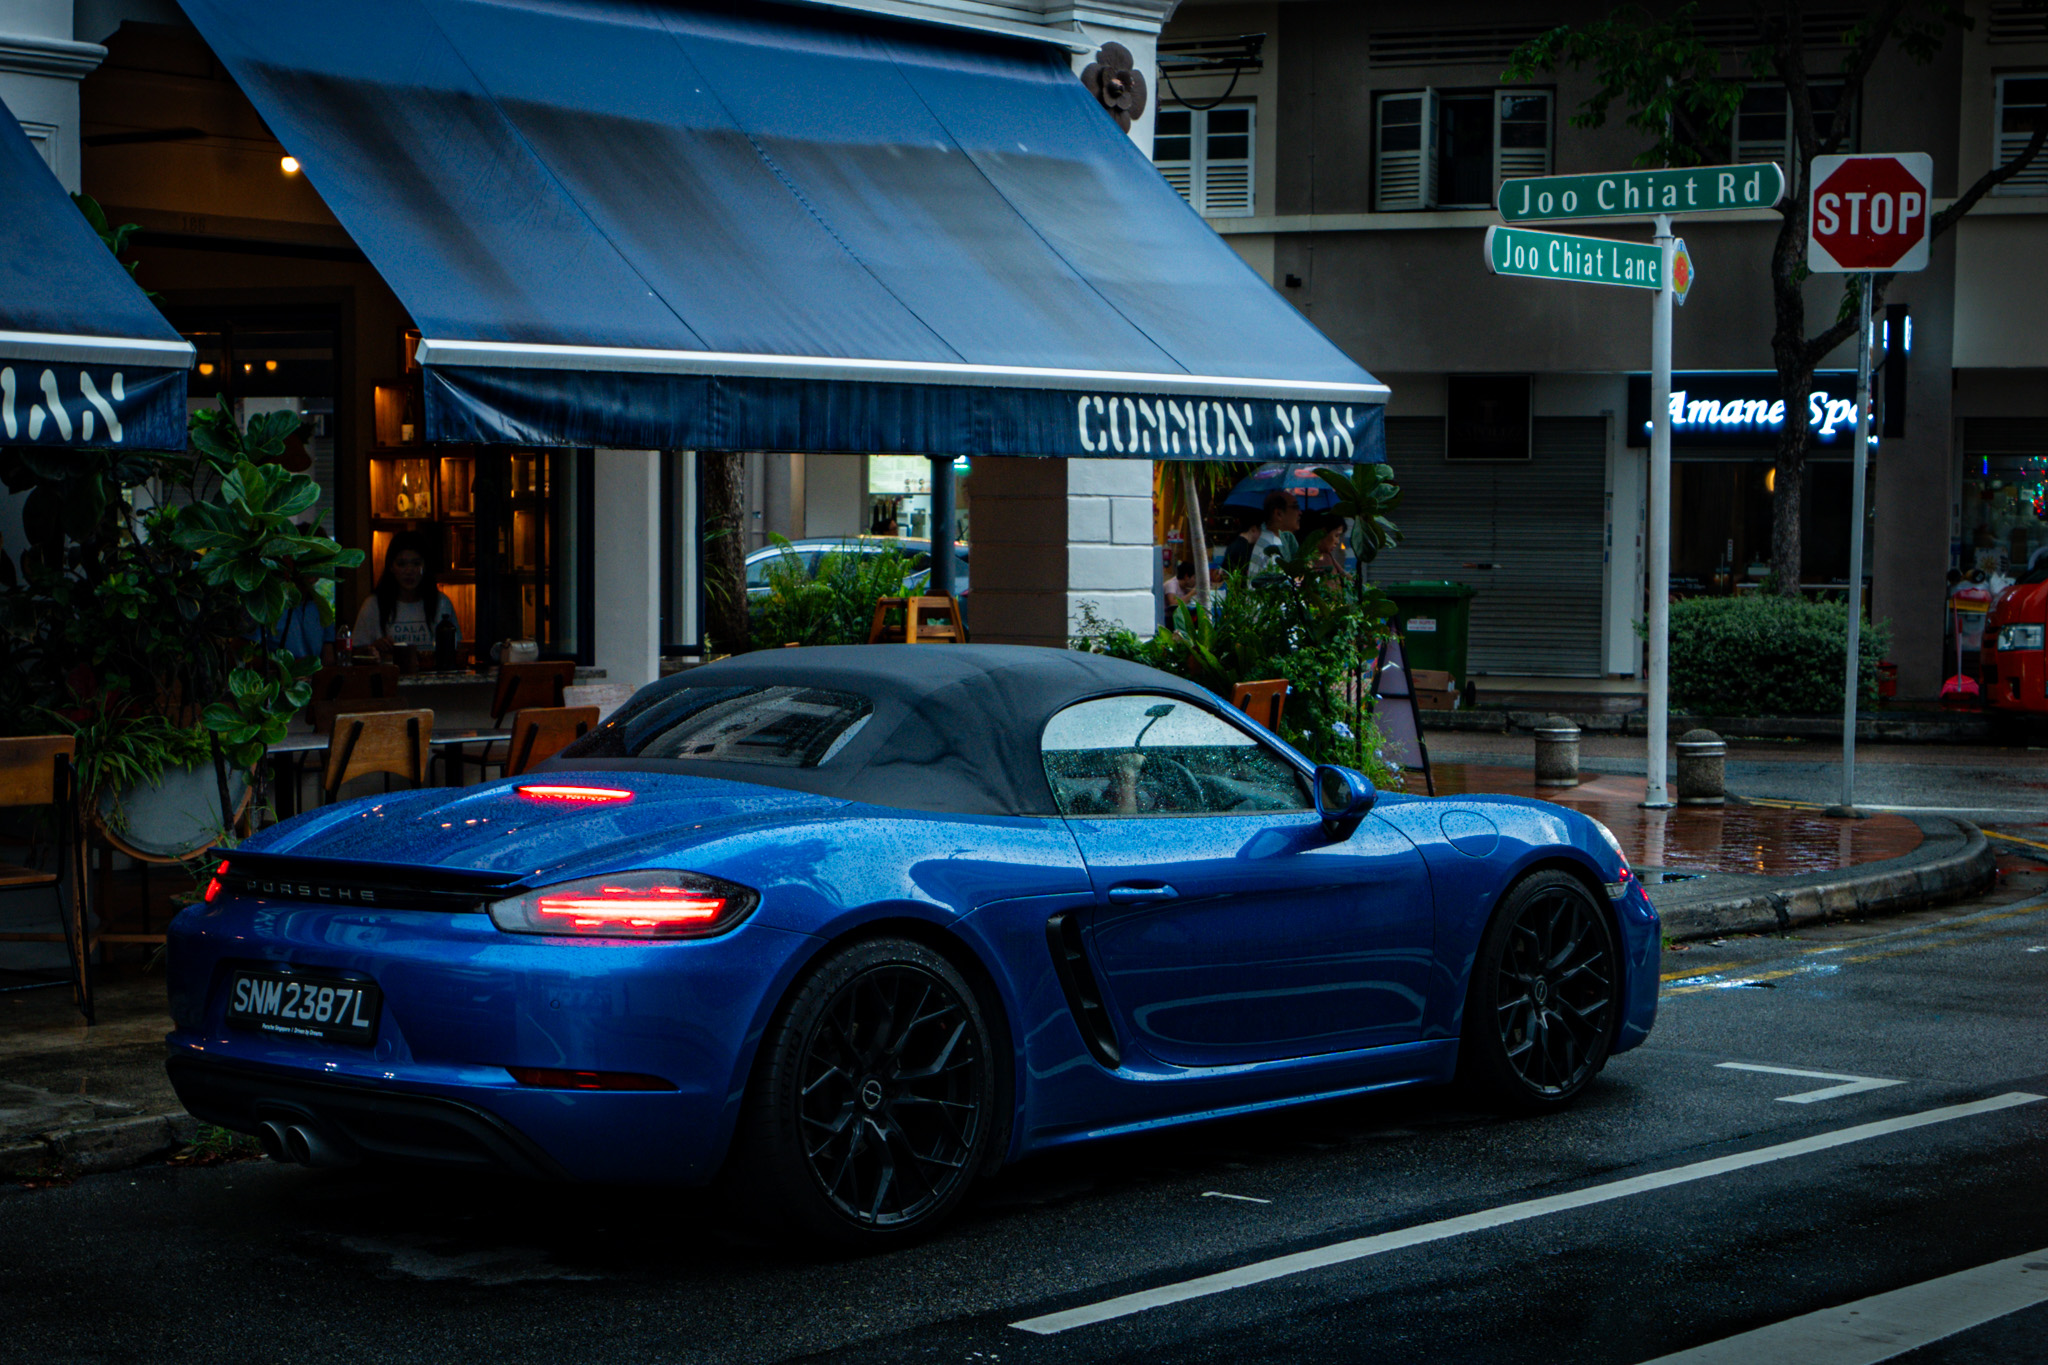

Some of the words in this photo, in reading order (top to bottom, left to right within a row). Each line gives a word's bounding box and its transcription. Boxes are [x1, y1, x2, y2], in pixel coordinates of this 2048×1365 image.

[1518, 184, 1578, 215] Joo
[1597, 176, 1698, 210] Chiat
[1718, 171, 1760, 203] Rd
[1817, 192, 1922, 236] STOP
[1502, 235, 1539, 270] Joo
[1548, 240, 1604, 277] Chiat
[1612, 247, 1657, 282] Lane
[1077, 395, 1255, 457] COMMON
[1275, 404, 1355, 458] MAN
[1646, 391, 1786, 425] Amane
[246, 880, 376, 902] PORSCHE
